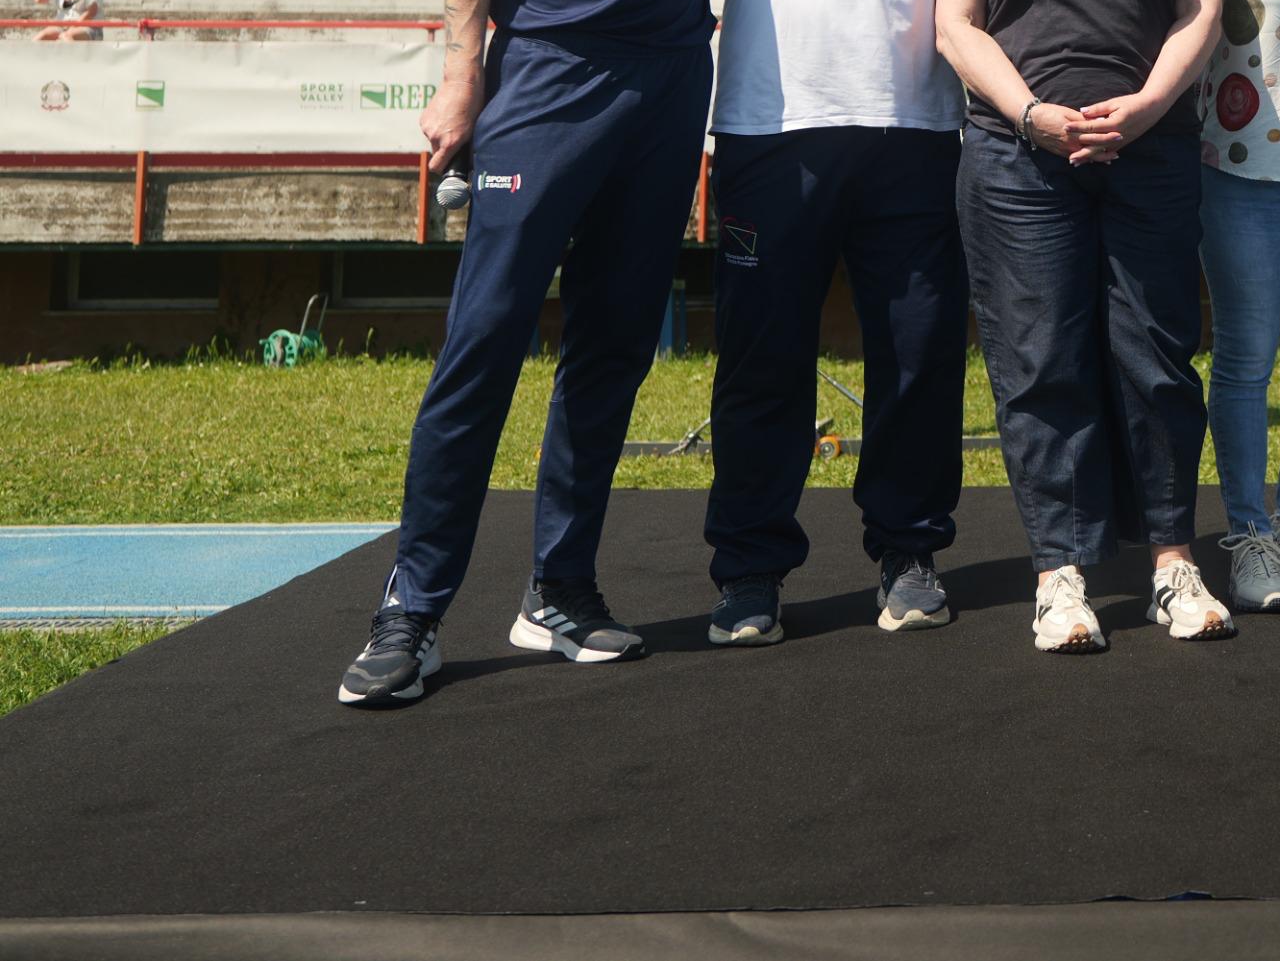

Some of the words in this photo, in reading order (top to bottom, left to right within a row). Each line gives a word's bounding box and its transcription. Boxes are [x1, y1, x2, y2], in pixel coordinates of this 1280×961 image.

[300, 83, 344, 92] SPORT
[300, 93, 344, 101] VALLEY
[485, 175, 512, 183] SPORT
